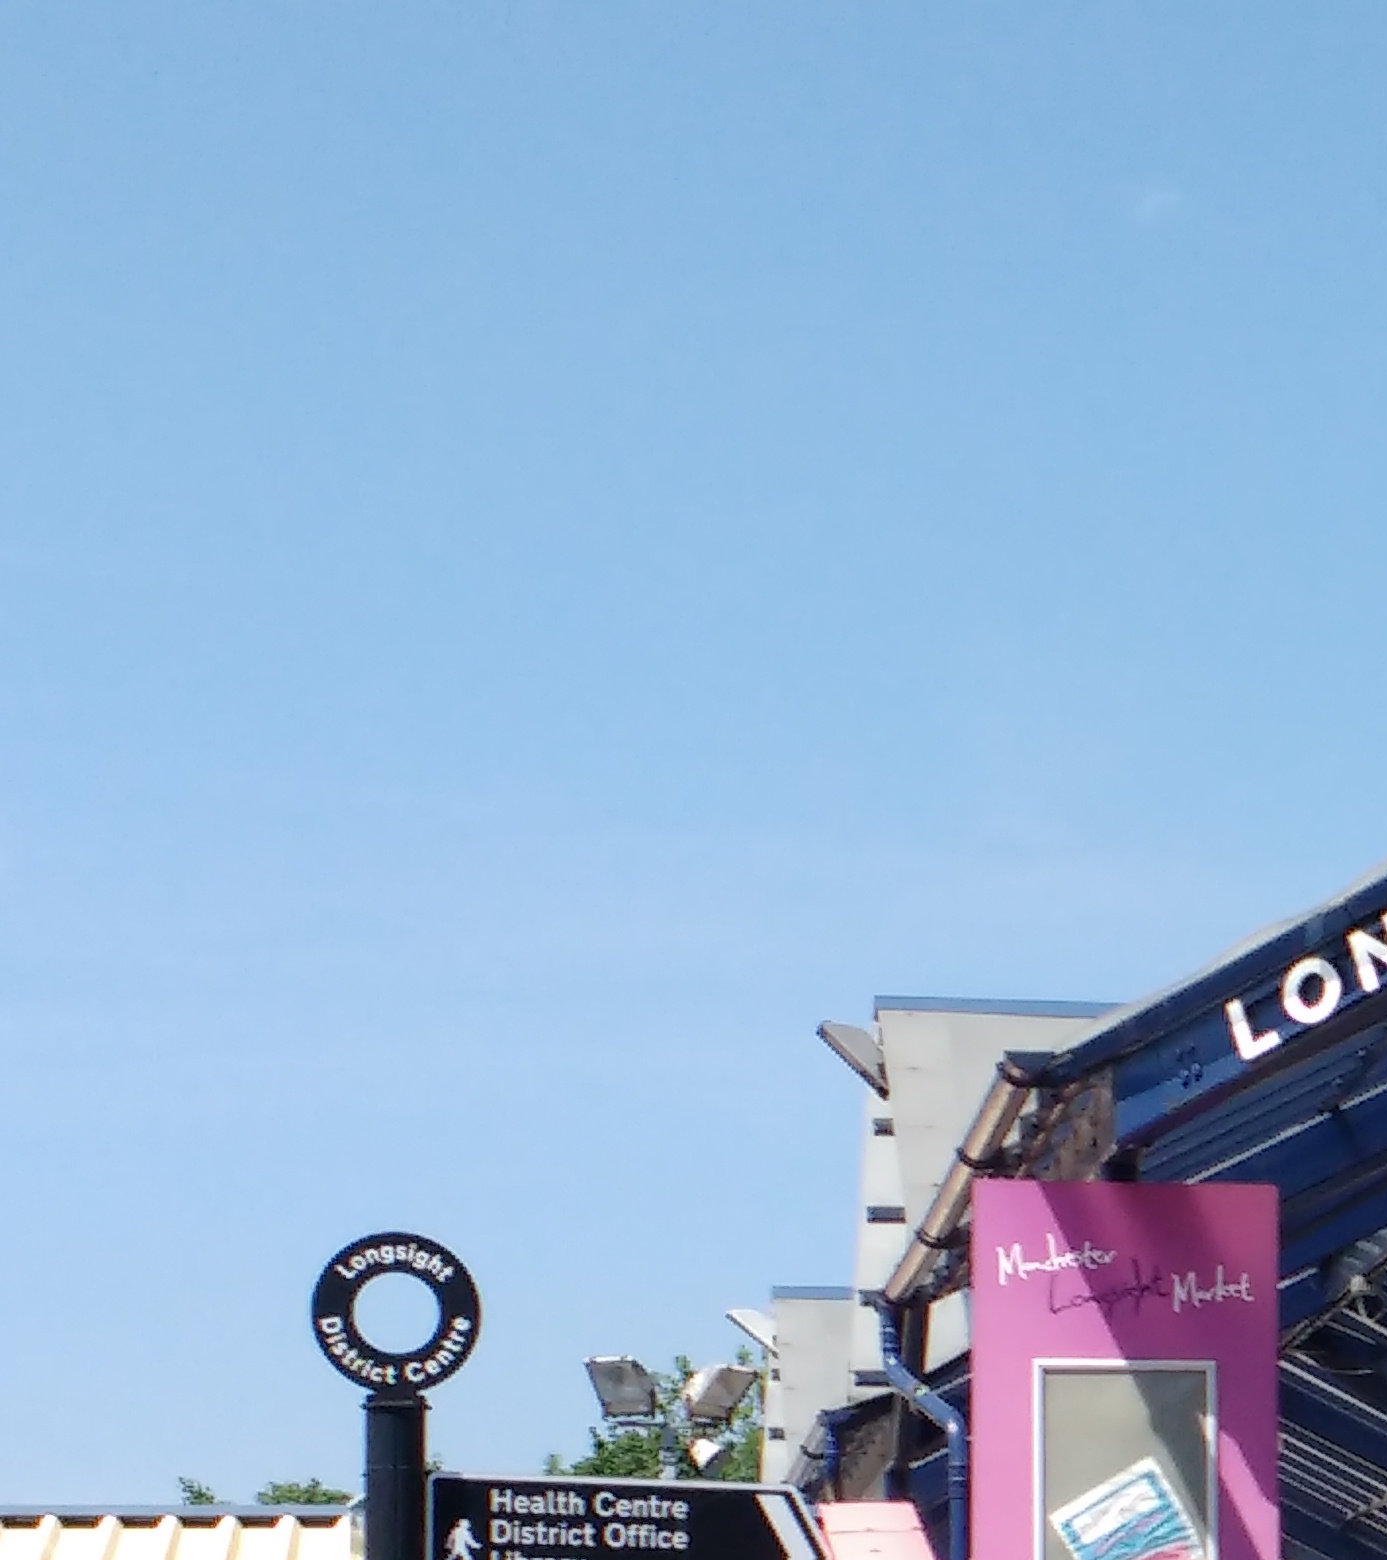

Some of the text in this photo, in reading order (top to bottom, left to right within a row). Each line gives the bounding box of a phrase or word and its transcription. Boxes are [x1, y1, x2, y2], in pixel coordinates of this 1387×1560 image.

[333, 1242, 453, 1282] Longsight
[995, 1233, 1116, 1285] Manchester
[1171, 1265, 1254, 1313] Market
[319, 1315, 472, 1385] District Centre
[489, 1488, 690, 1519] Health Centre
[489, 1519, 691, 1549] District Office
